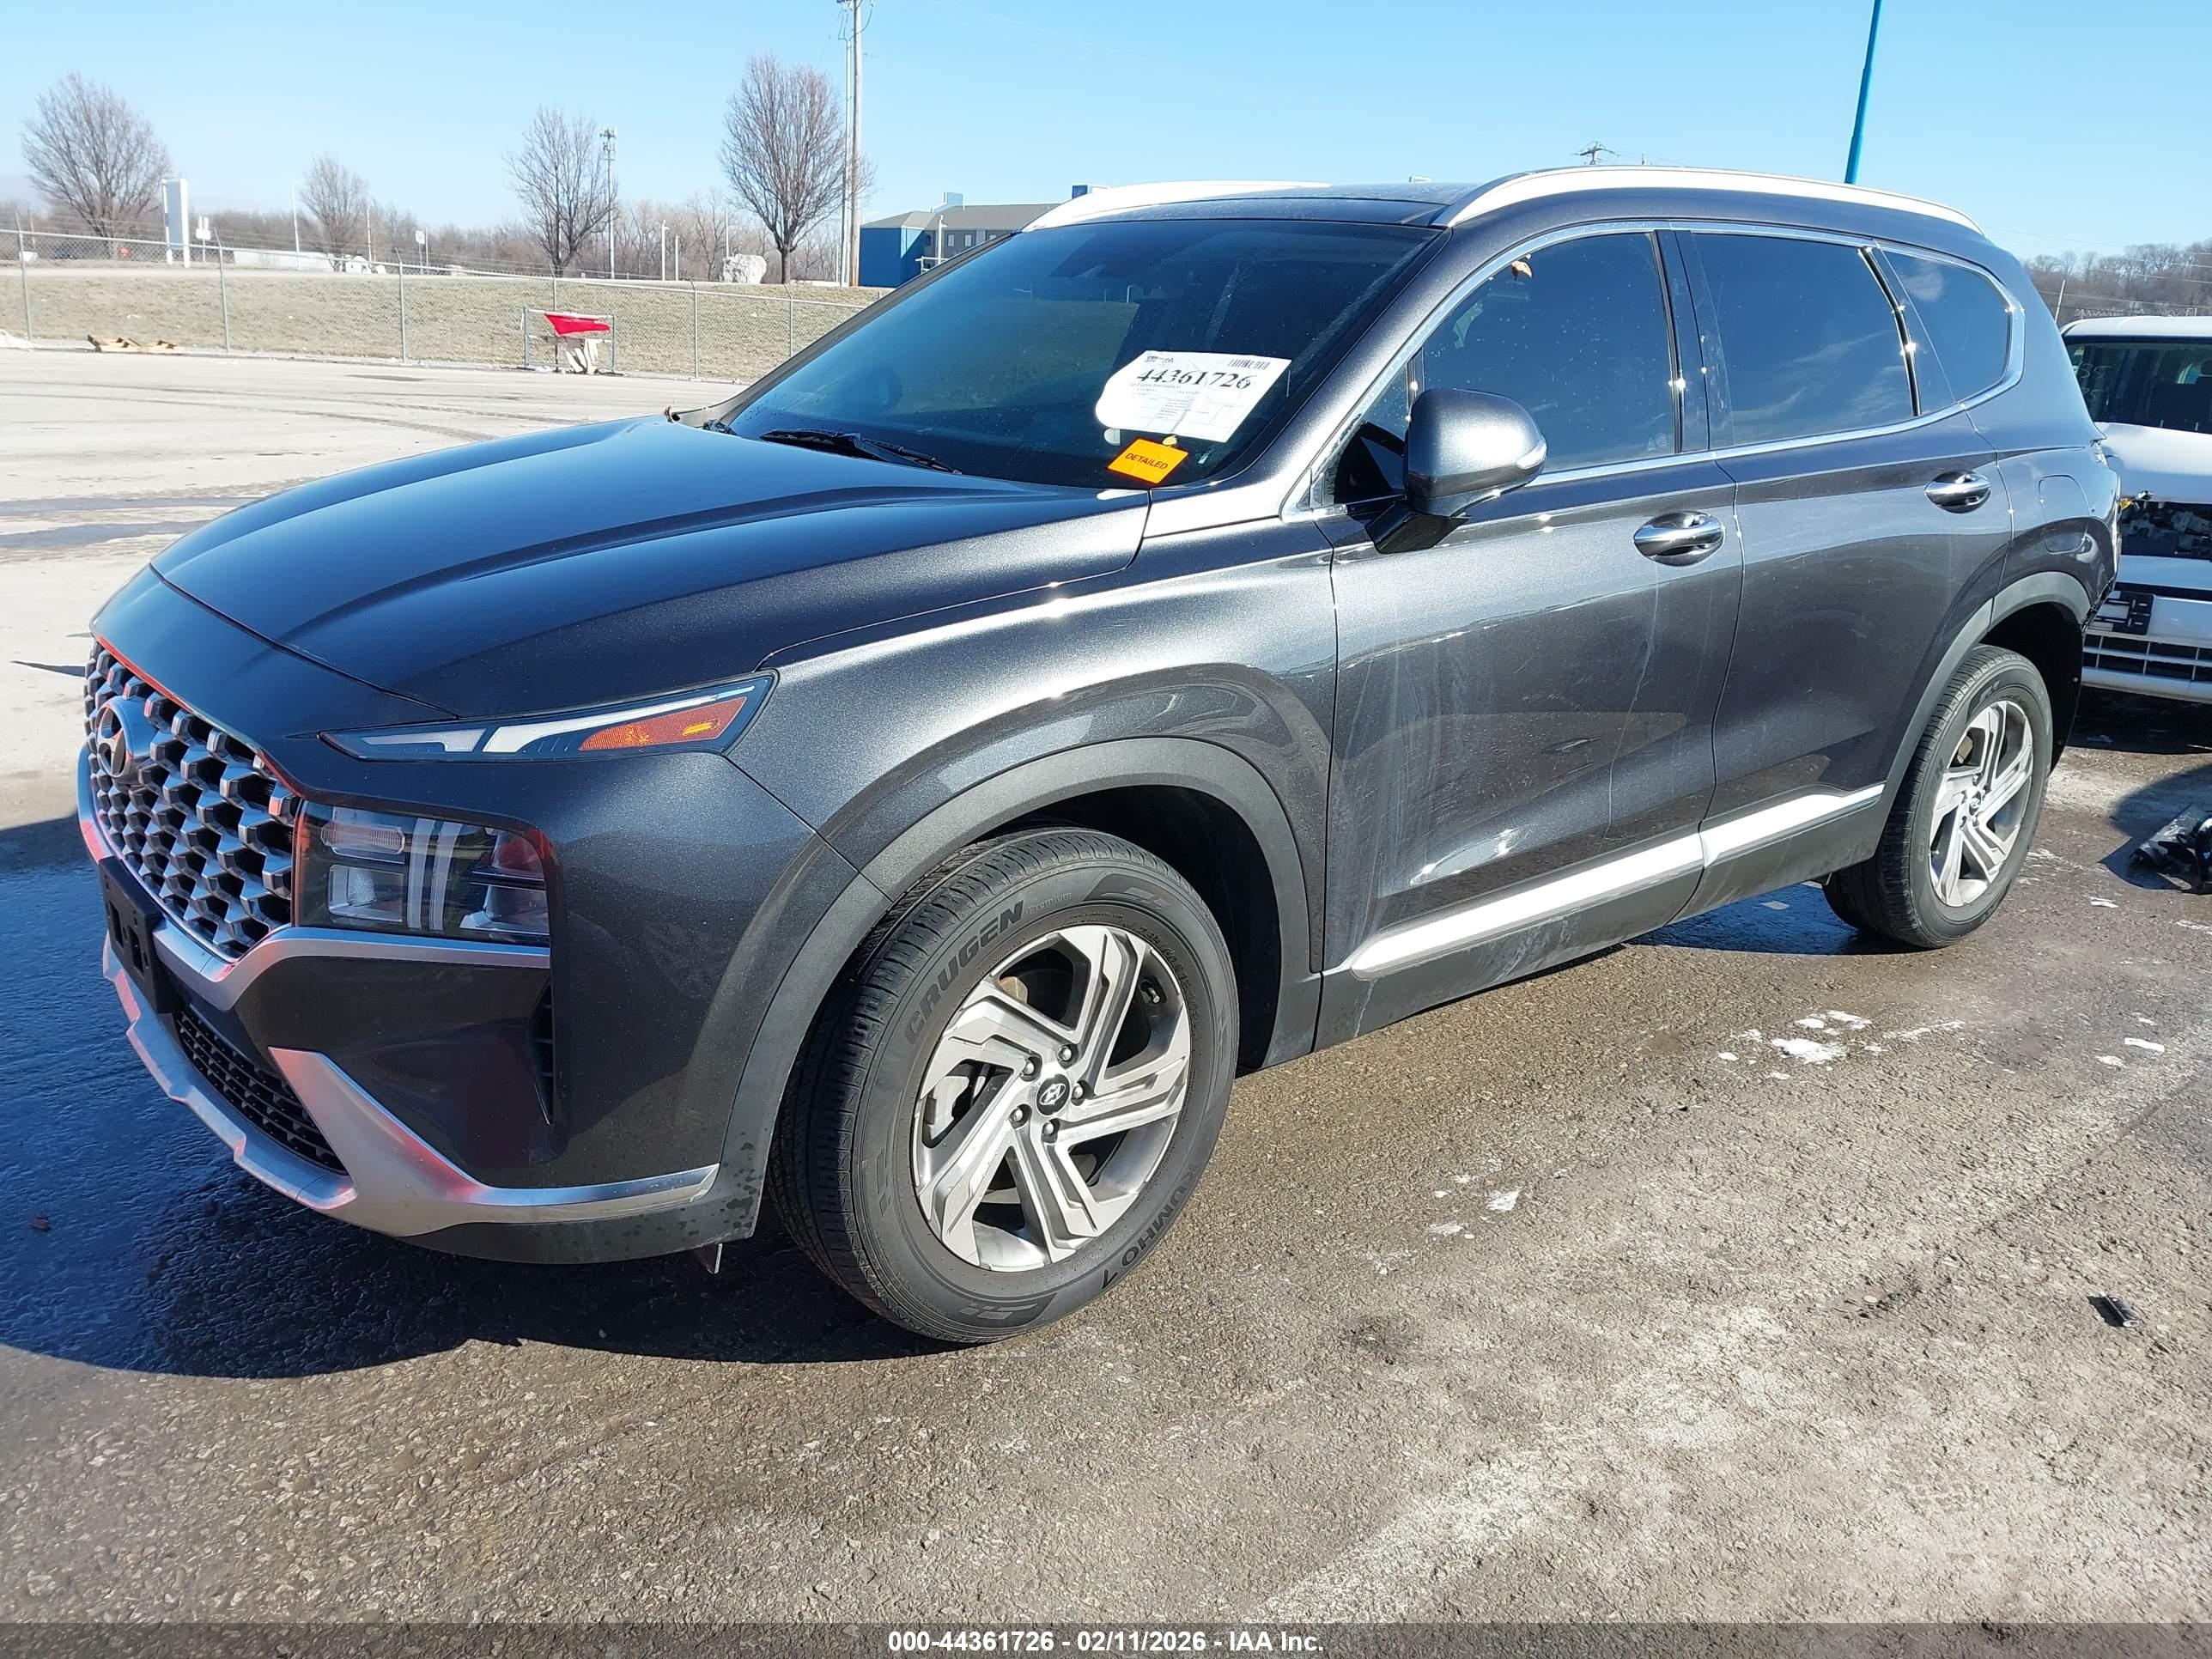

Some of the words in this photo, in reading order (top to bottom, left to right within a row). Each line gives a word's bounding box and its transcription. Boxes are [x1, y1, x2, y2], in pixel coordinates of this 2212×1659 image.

[1136, 368, 1257, 390] 44361726
[1125, 453, 1168, 470] DETAILED
[903, 899, 1024, 1045] CRUGEN
[1121, 1163, 1200, 1268] KUMHO
